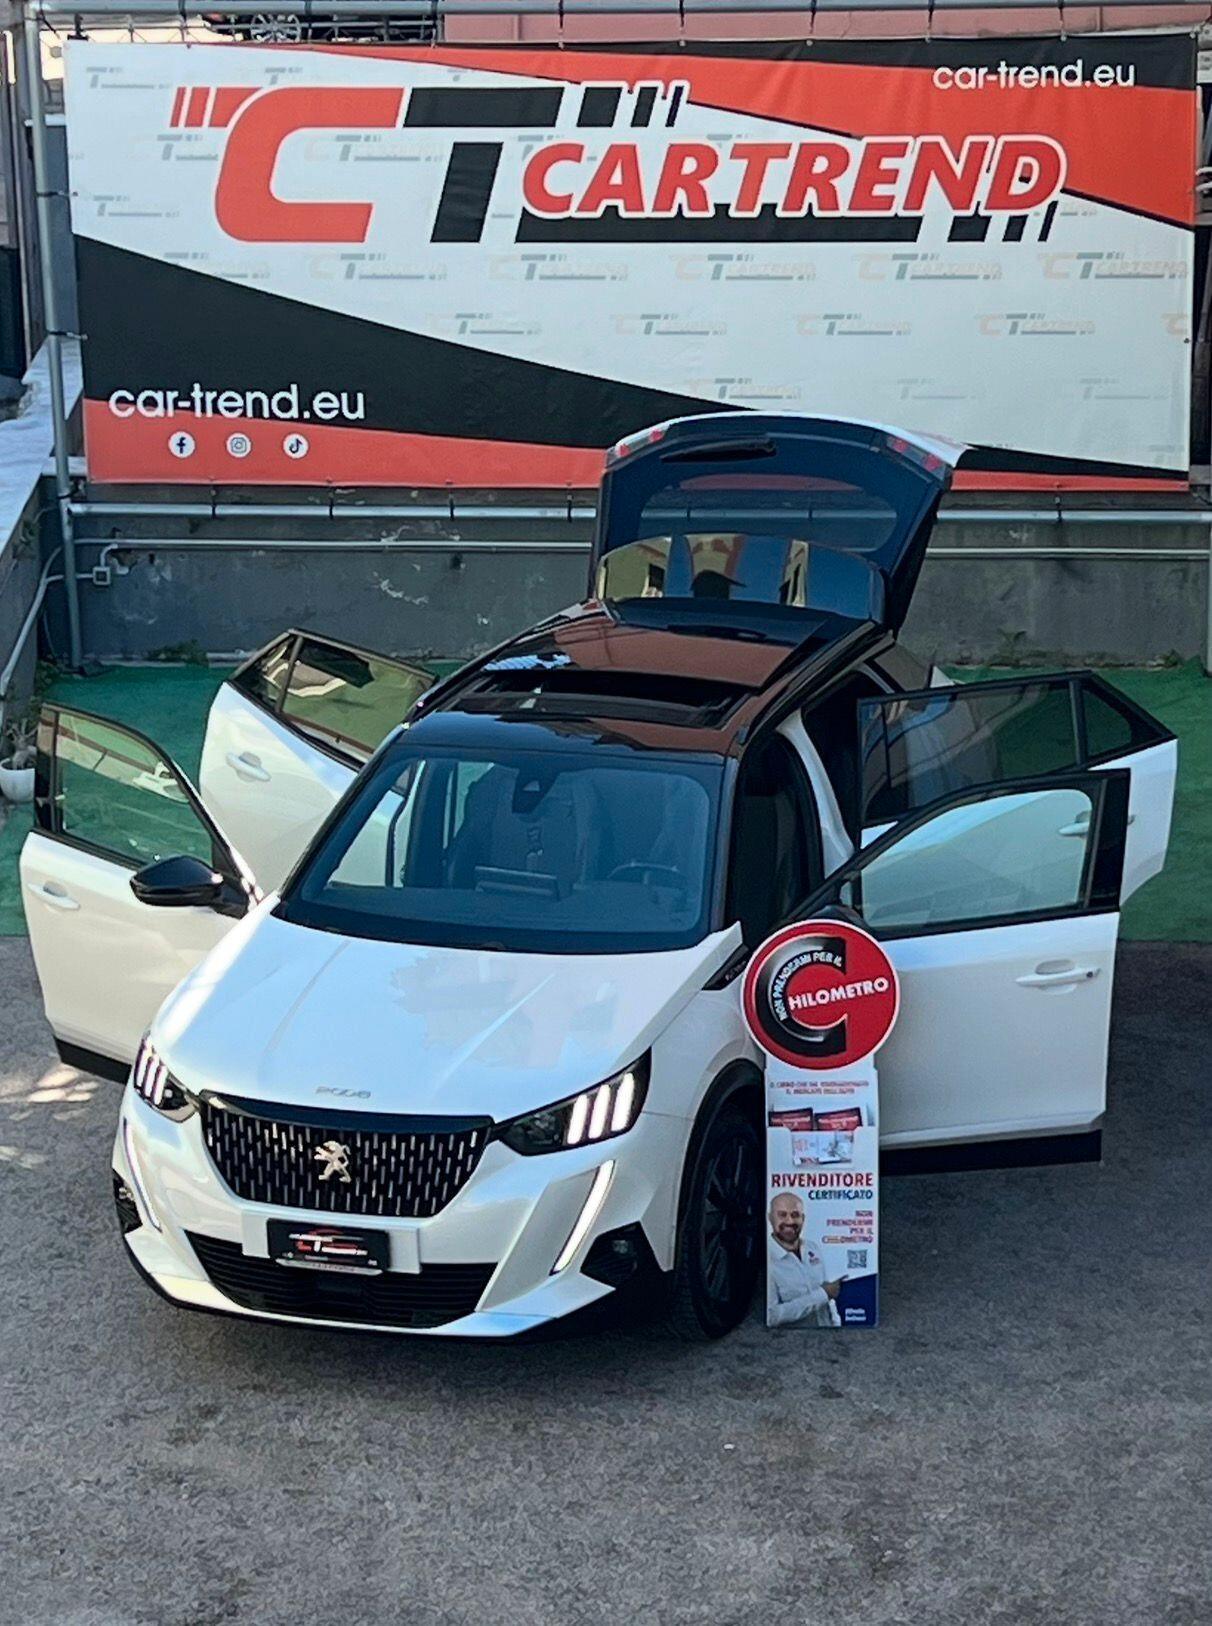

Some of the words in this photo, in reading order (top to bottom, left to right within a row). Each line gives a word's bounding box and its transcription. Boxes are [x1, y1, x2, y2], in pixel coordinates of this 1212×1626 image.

[931, 59, 1136, 90] car-trend.eu
[521, 135, 1065, 217] CARTREND
[108, 382, 366, 421] car-trend.eu
[812, 951, 833, 963] PER
[771, 1173, 874, 1188] RIVENDITORE
[808, 1189, 873, 1200] CERTIFICATO
